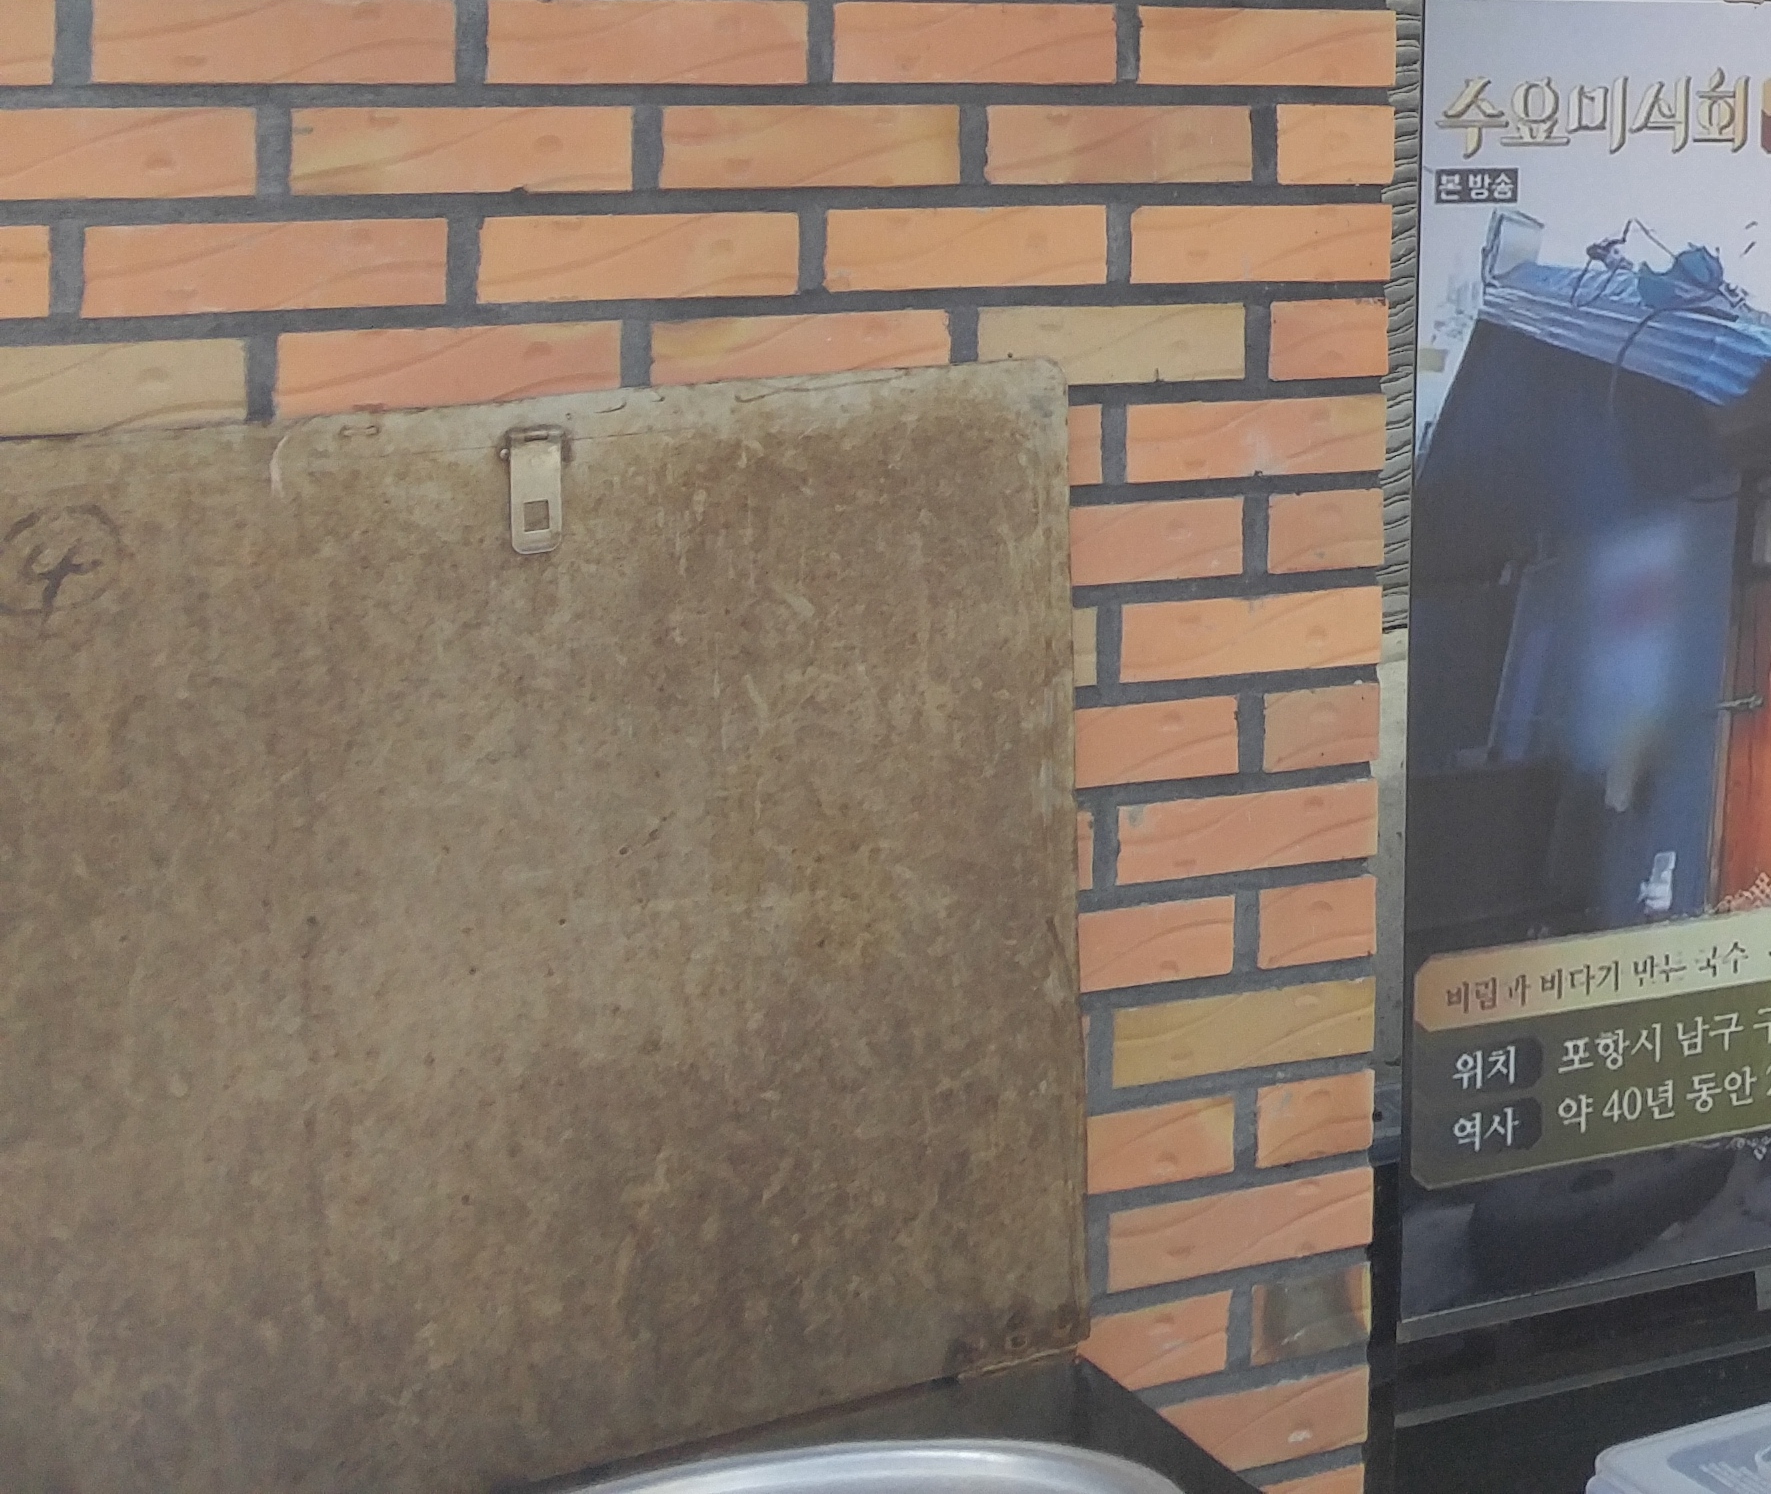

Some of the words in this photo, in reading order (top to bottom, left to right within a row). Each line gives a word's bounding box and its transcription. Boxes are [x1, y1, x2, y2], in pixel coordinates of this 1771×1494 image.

[1435, 67, 1751, 160] 수요미식회
[1452, 1047, 1517, 1091] 위치
[1557, 1024, 1664, 1076] 포항시
[1677, 1017, 1745, 1059] 남구
[1452, 1107, 1519, 1152] 역사
[1557, 1095, 1594, 1135] 약
[1602, 1084, 1677, 1124] 40년
[1685, 1068, 1758, 1112] 동안
